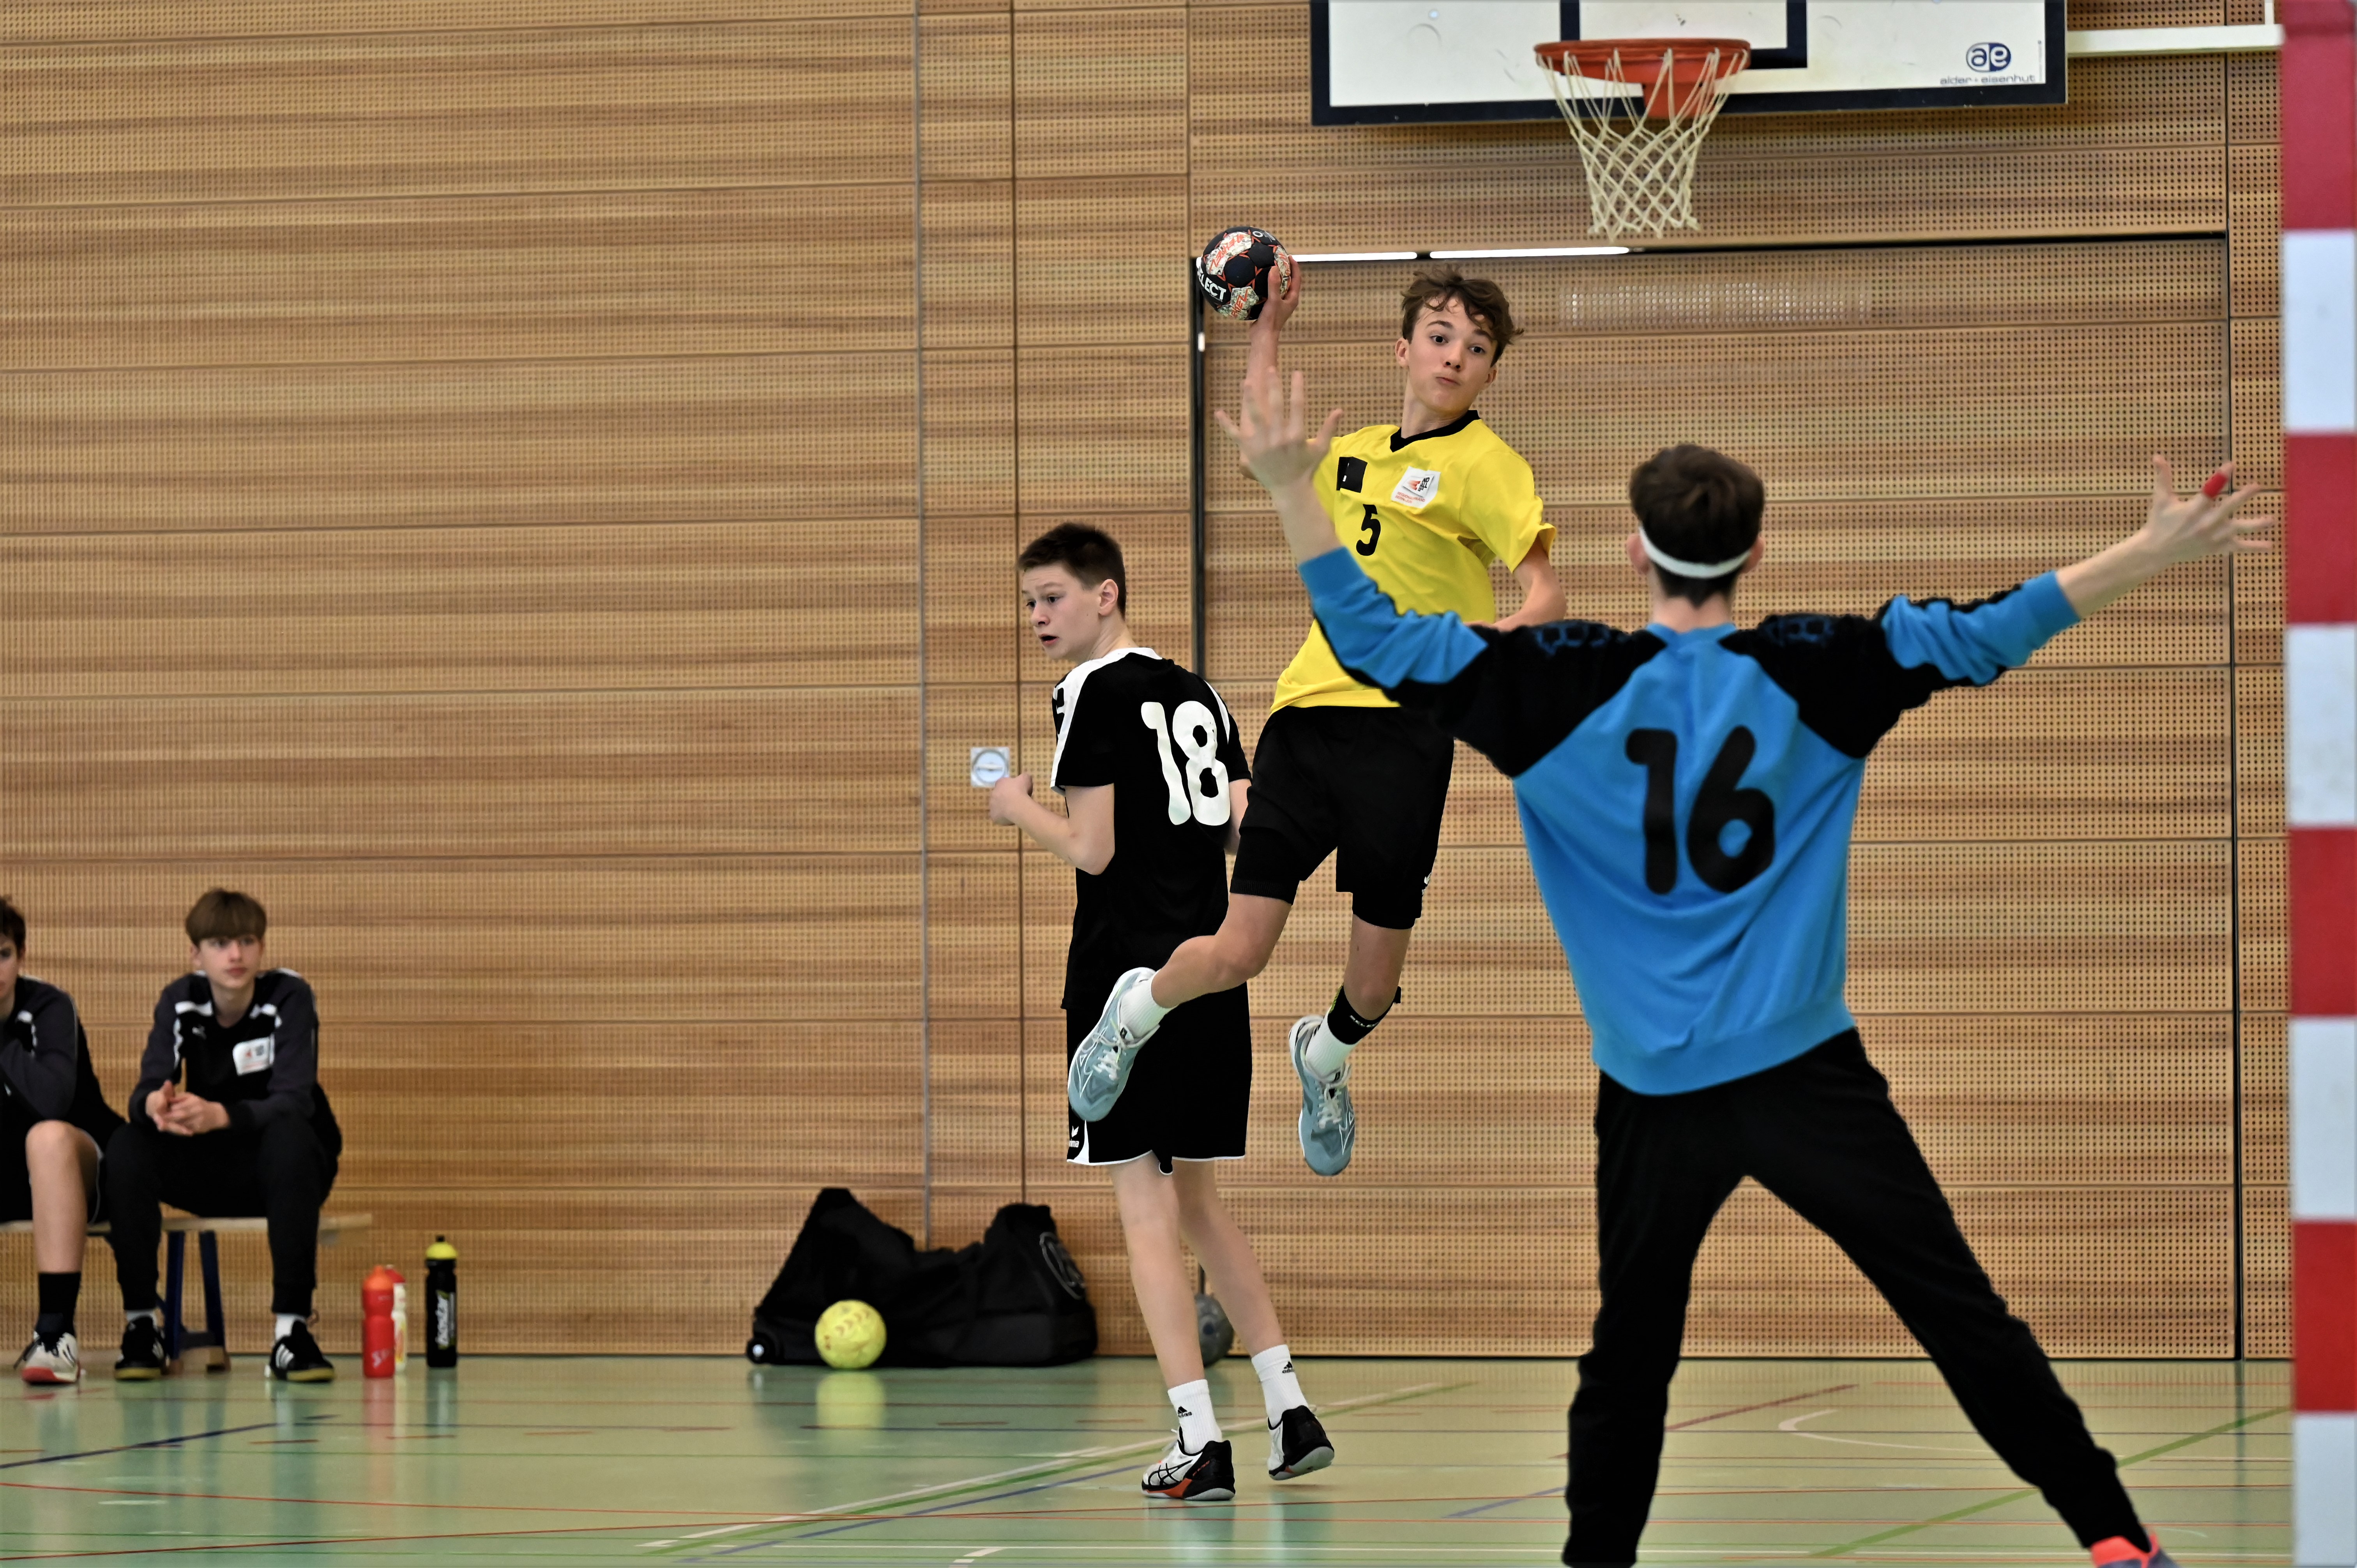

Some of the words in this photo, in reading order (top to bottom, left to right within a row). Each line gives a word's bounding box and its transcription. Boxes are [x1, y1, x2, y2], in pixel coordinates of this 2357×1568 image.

[1940, 76, 1971, 85] alder
[1981, 74, 2035, 83] eisenhut
[1356, 504, 1381, 556] 5
[1141, 701, 1230, 826] 18
[1625, 725, 1775, 895] 16
